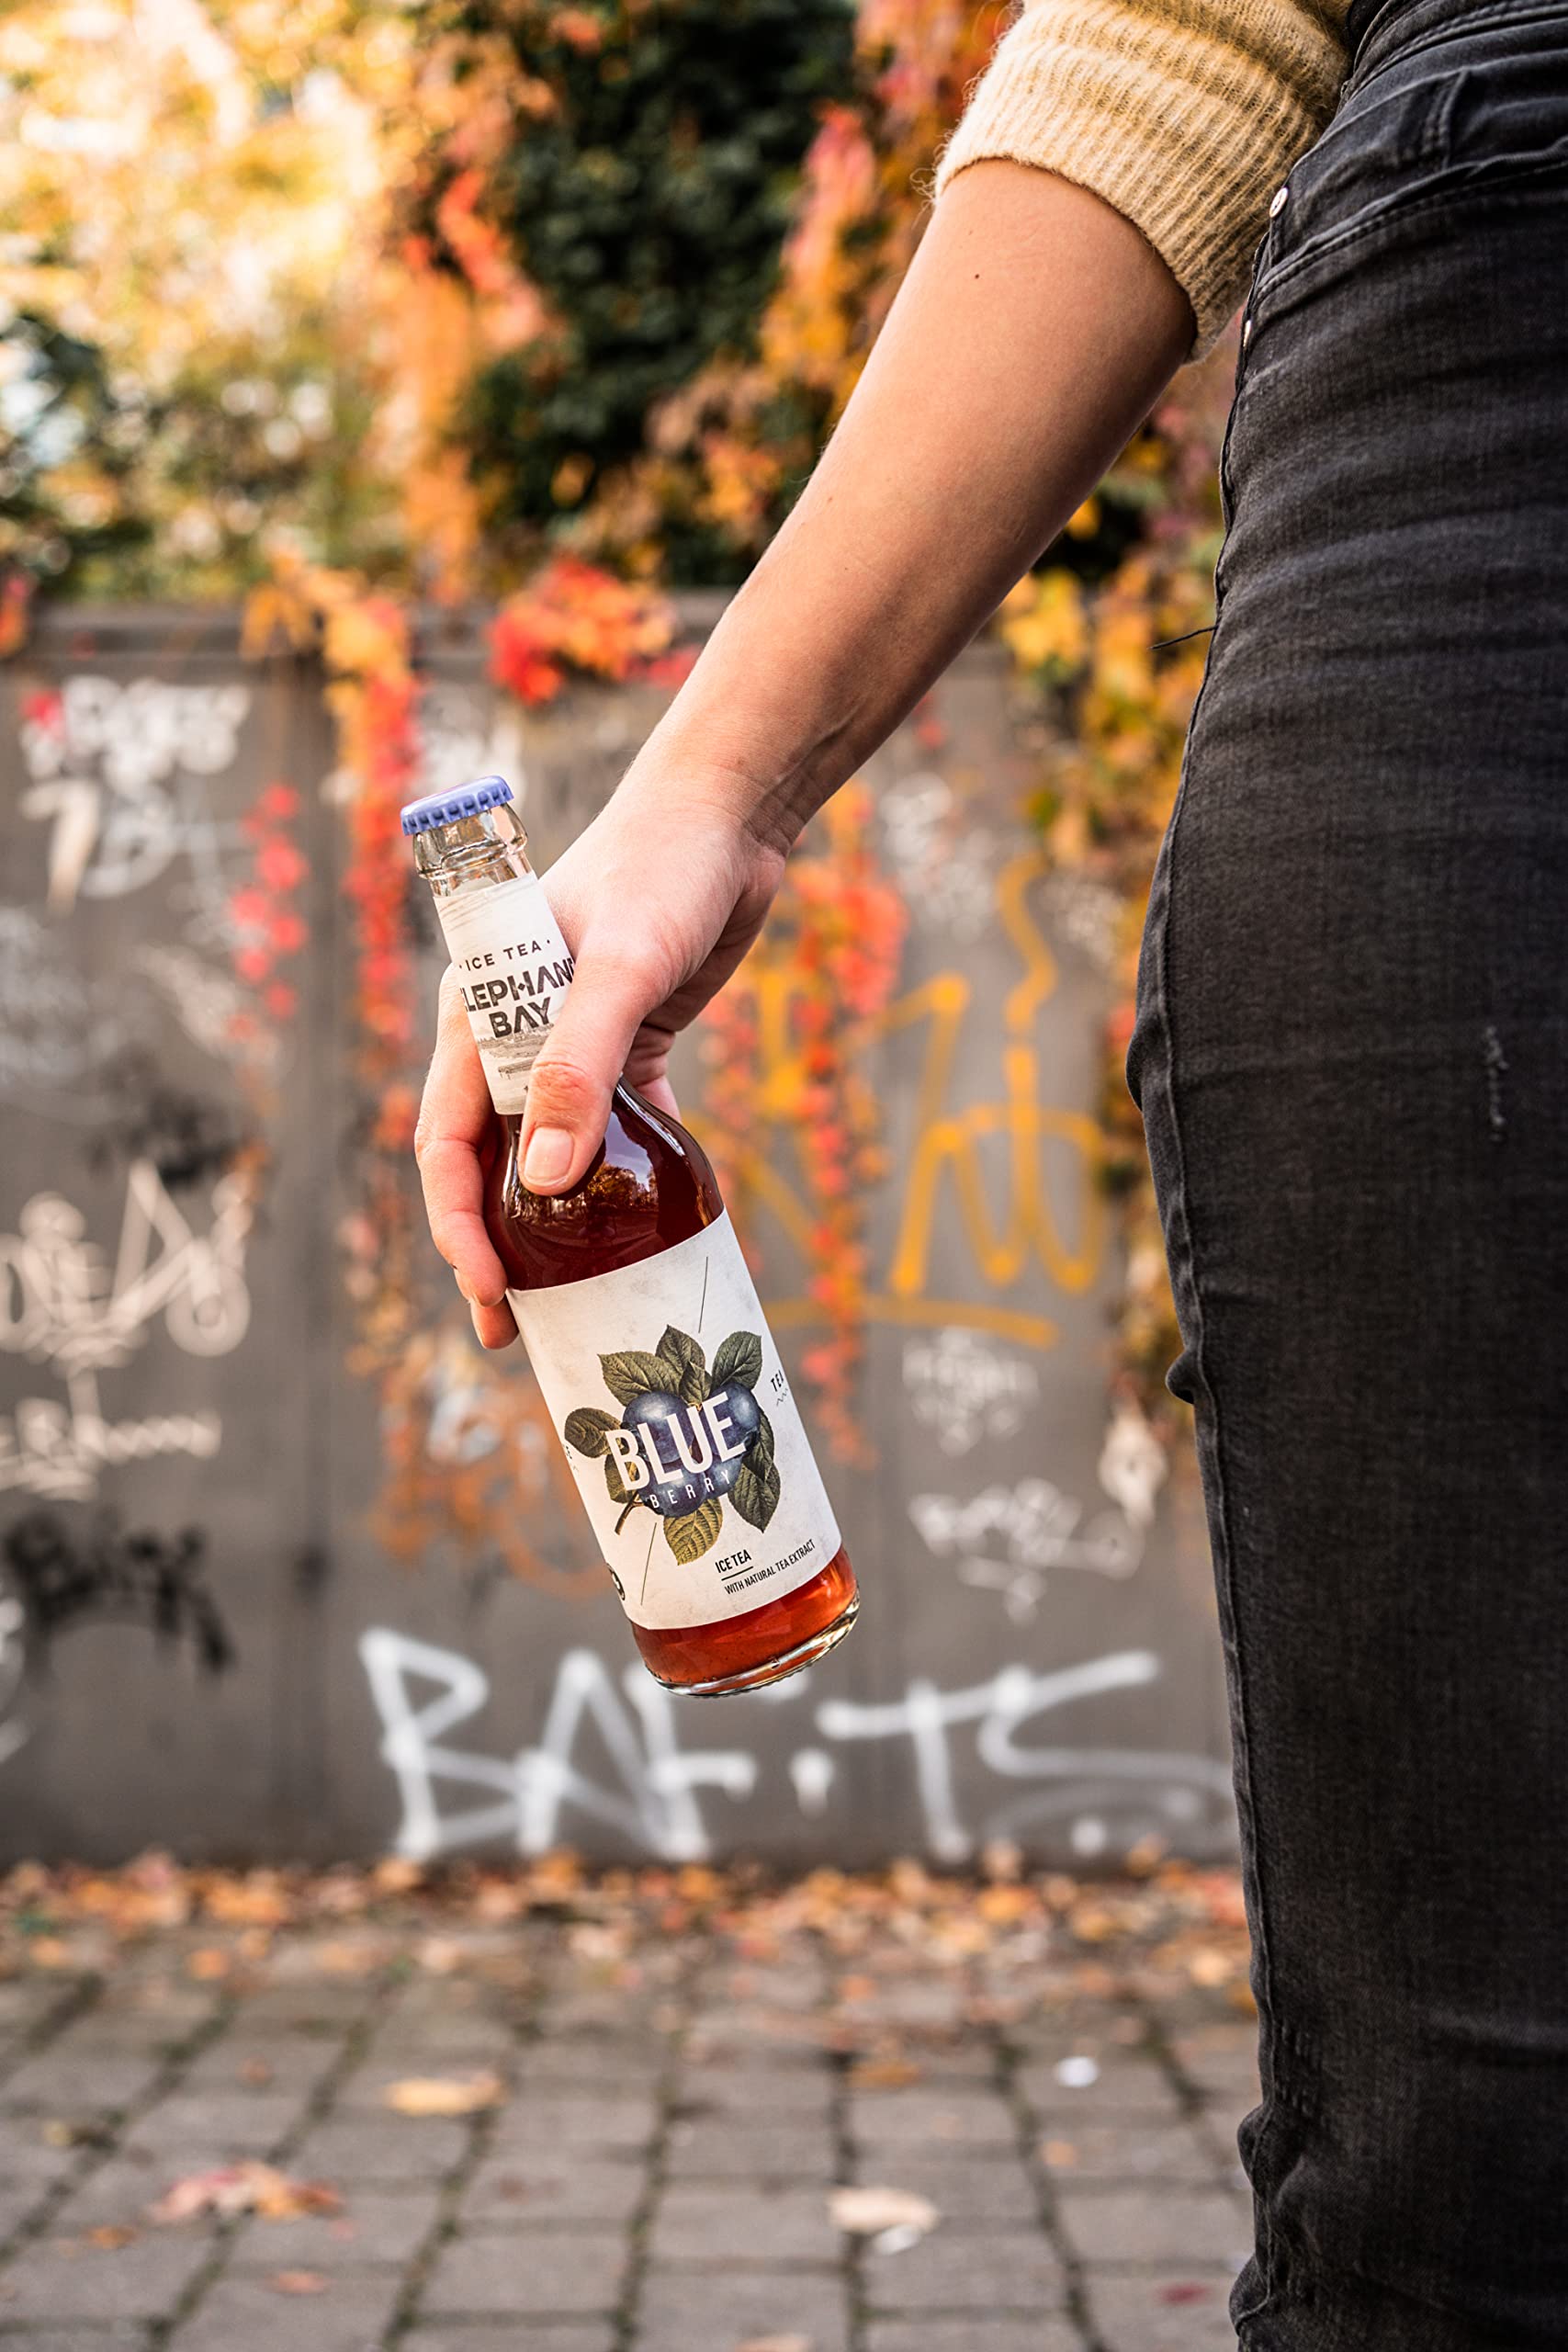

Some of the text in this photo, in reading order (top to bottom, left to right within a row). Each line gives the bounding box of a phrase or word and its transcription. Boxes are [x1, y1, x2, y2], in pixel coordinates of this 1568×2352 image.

[465, 940, 542, 971] ICE TEA
[459, 956, 575, 1012] LEPHAN
[488, 996, 551, 1038] BAY
[604, 1391, 747, 1491] BLUE
[649, 1469, 731, 1510] BERRY
[715, 1548, 752, 1574] ICE TEA
[724, 1538, 816, 1595] WITH NATURAL TEA EXTRACT
